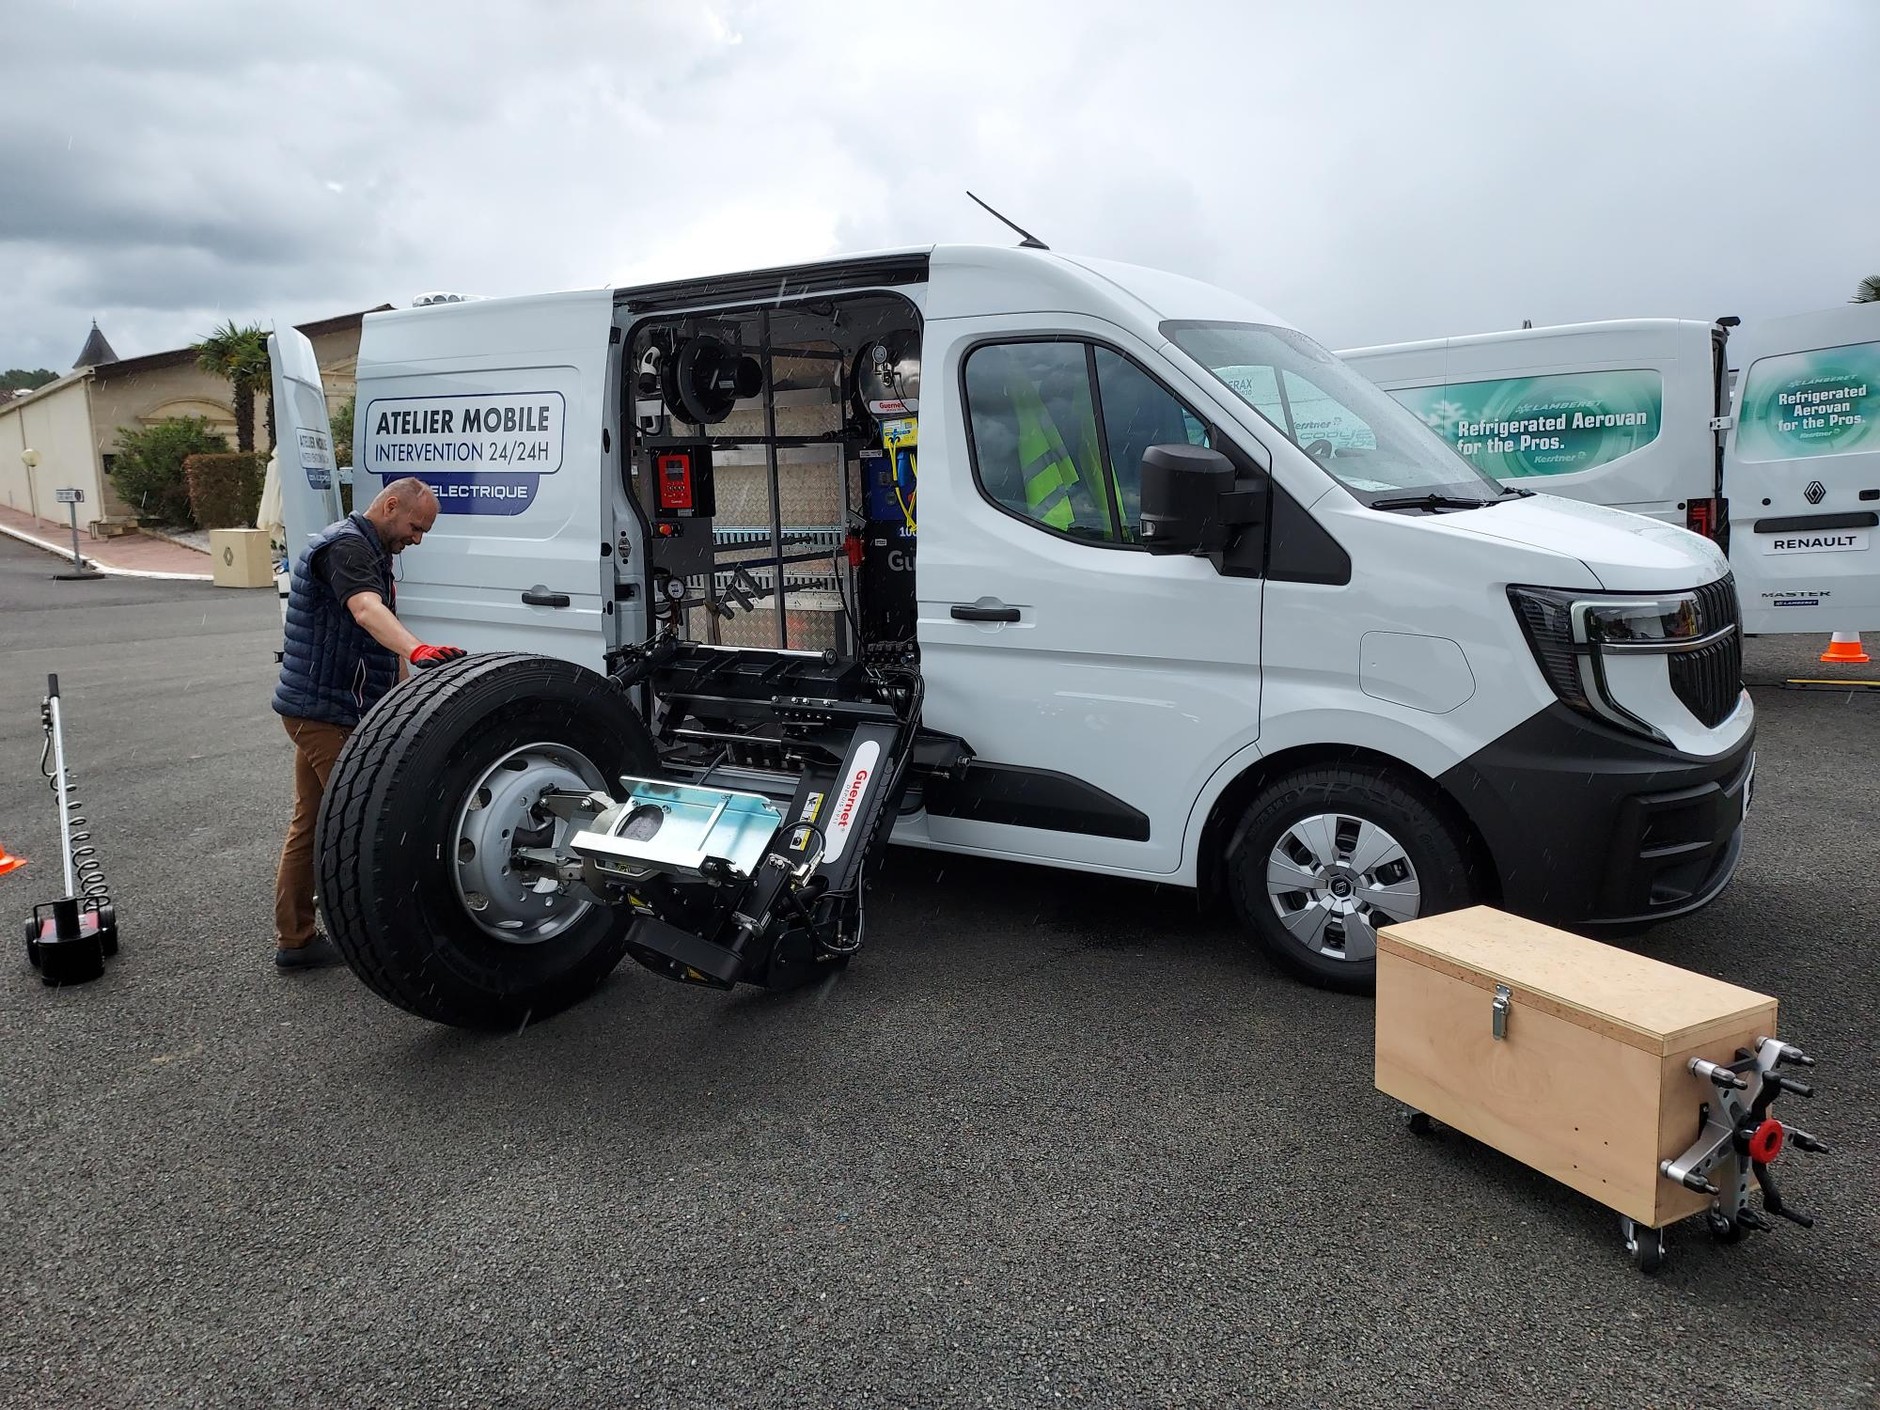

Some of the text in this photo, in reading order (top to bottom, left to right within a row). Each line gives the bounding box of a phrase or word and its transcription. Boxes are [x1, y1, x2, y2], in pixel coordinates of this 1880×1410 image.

[1778, 384, 1867, 406] Refrigerated
[1793, 402, 1851, 417] Aerovan
[375, 406, 550, 436] ATELIER MOBILE
[1458, 411, 1647, 438] Refrigerated Aerovan
[1777, 414, 1867, 432] for the Pros.
[375, 440, 549, 466] INTERVENTION 24/24H
[1456, 434, 1565, 455] for the Pros.
[1773, 536, 1857, 550] RENAULT
[838, 770, 868, 827] Guernet
